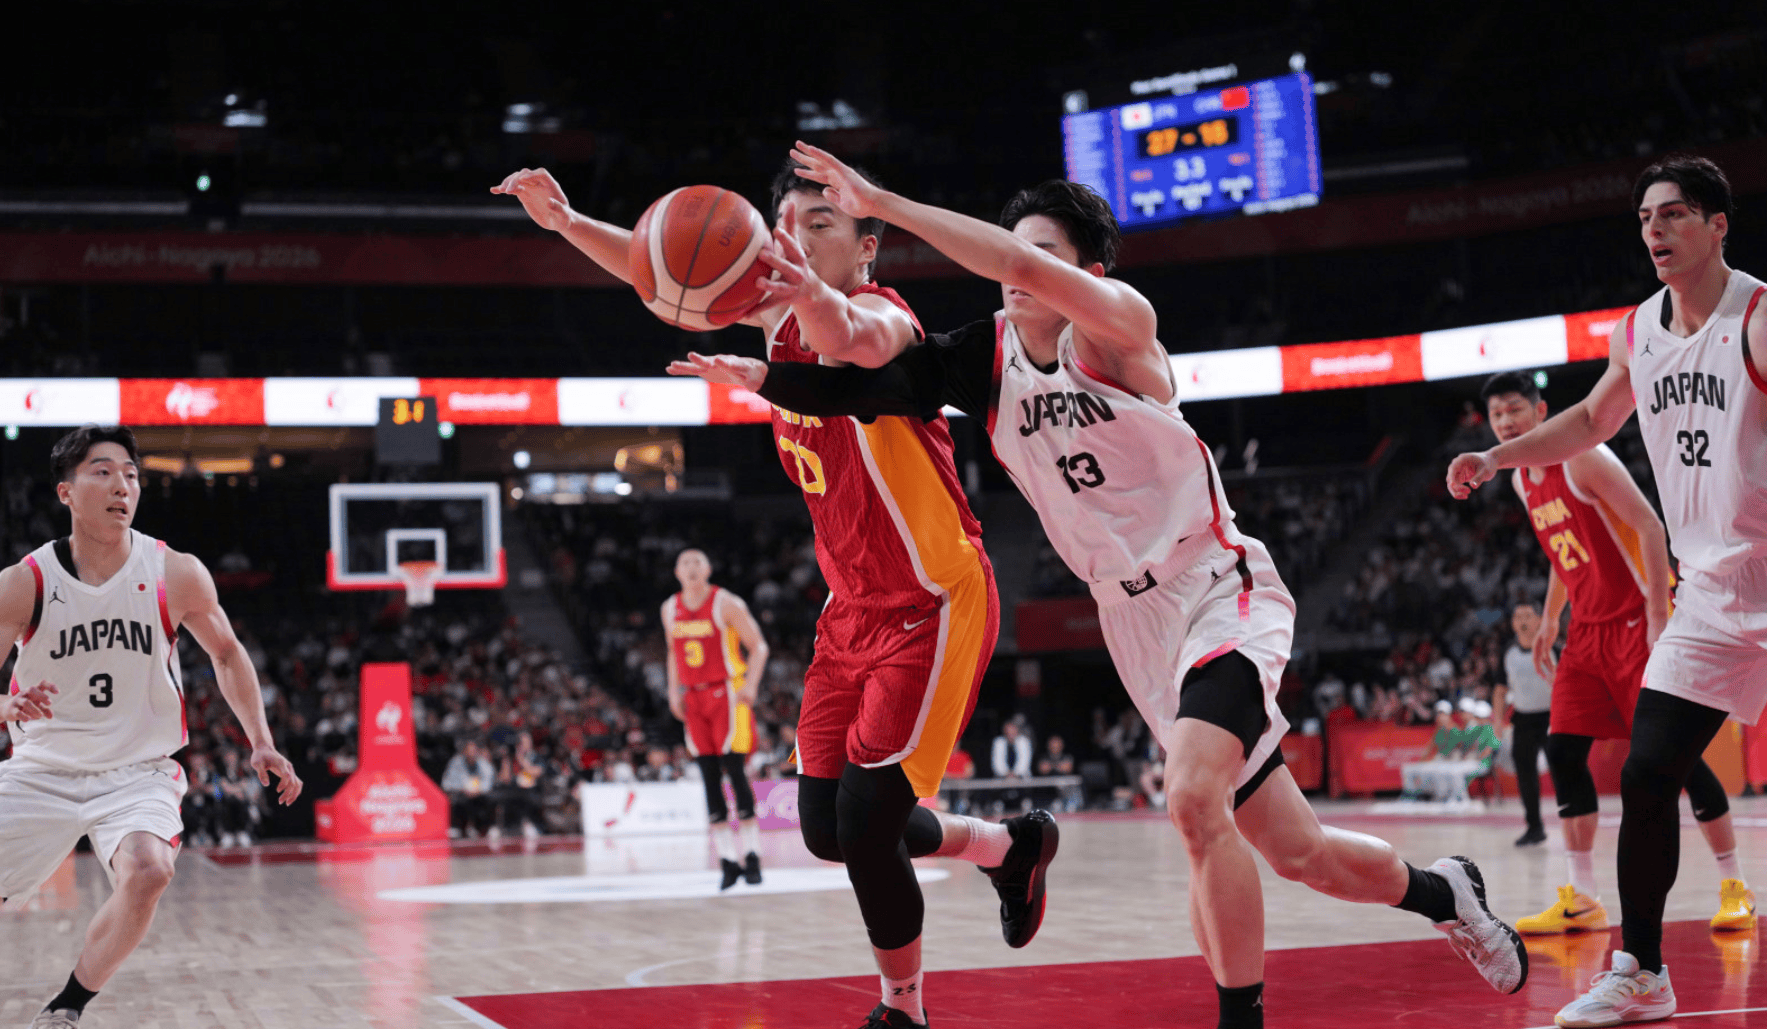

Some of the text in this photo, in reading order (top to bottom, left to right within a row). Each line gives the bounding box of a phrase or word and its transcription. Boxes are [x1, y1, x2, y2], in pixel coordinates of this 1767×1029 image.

[1018, 391, 1116, 437] JAPAN
[1651, 372, 1726, 415] JAPAN
[1676, 429, 1712, 468] 32
[1056, 451, 1106, 494] 13
[1549, 529, 1590, 572] 21
[50, 618, 152, 660] JAPAN
[684, 640, 705, 668] 3
[89, 673, 113, 708] 3
